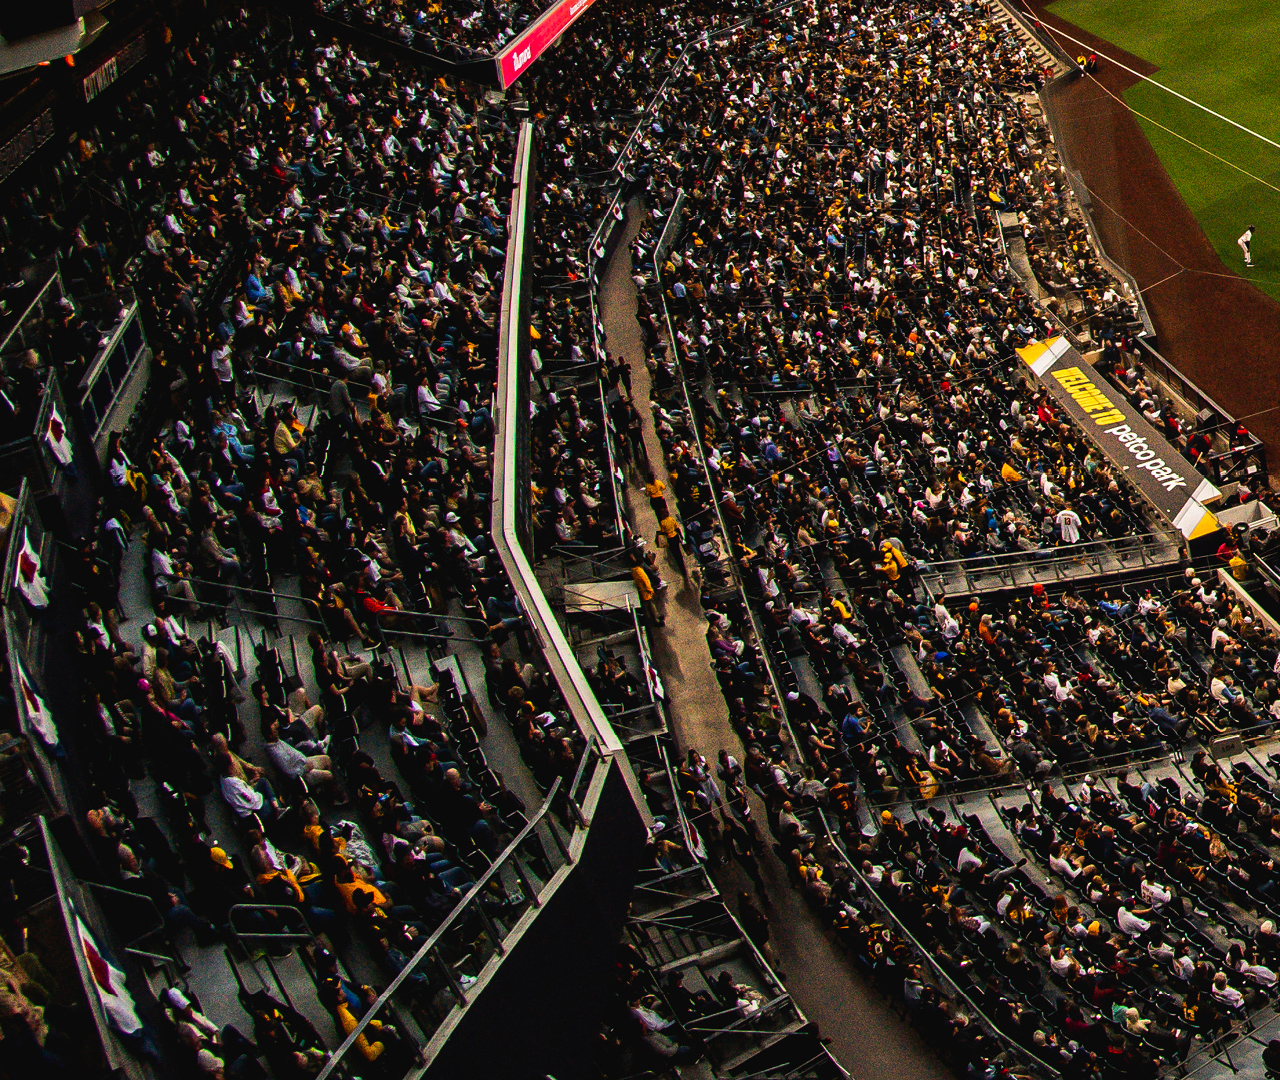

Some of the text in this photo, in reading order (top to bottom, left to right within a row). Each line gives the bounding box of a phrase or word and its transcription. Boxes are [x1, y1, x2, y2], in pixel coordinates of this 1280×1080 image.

[1051, 366, 1126, 426] WELCOME TO
[1103, 424, 1187, 492] petco park
[1064, 518, 1070, 526] 13
